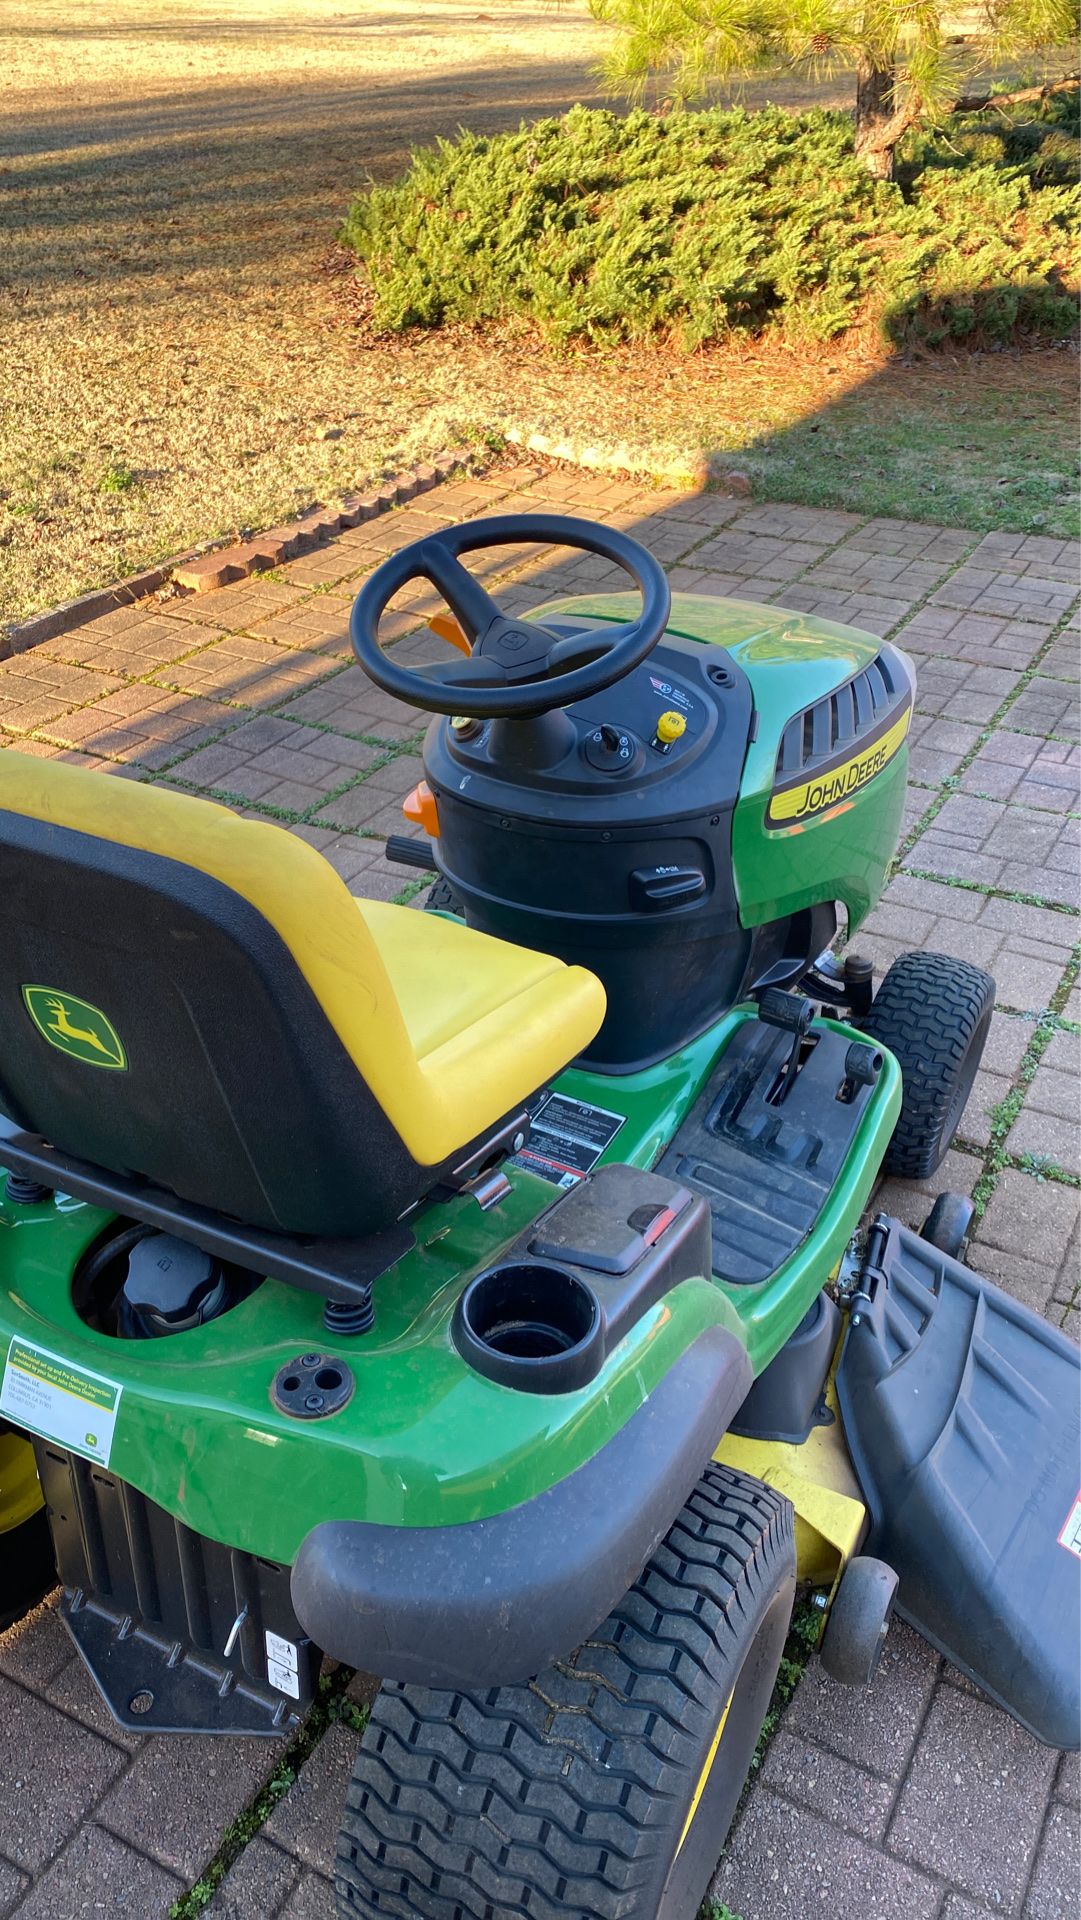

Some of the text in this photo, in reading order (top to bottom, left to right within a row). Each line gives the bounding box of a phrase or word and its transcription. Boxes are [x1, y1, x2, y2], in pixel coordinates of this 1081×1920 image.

[797, 745, 887, 814] JOHN DEERE
[13, 1356, 31, 1369] provided
[31, 1364, 36, 1372] by
[36, 1367, 46, 1376] your
[46, 1371, 57, 1381] local
[57, 1376, 68, 1386] John
[68, 1381, 81, 1392] Deere
[14, 1348, 40, 1365] Professional
[46, 1363, 53, 1372] up
[52, 1366, 62, 1375] and
[87, 1382, 111, 1400] Inspection
